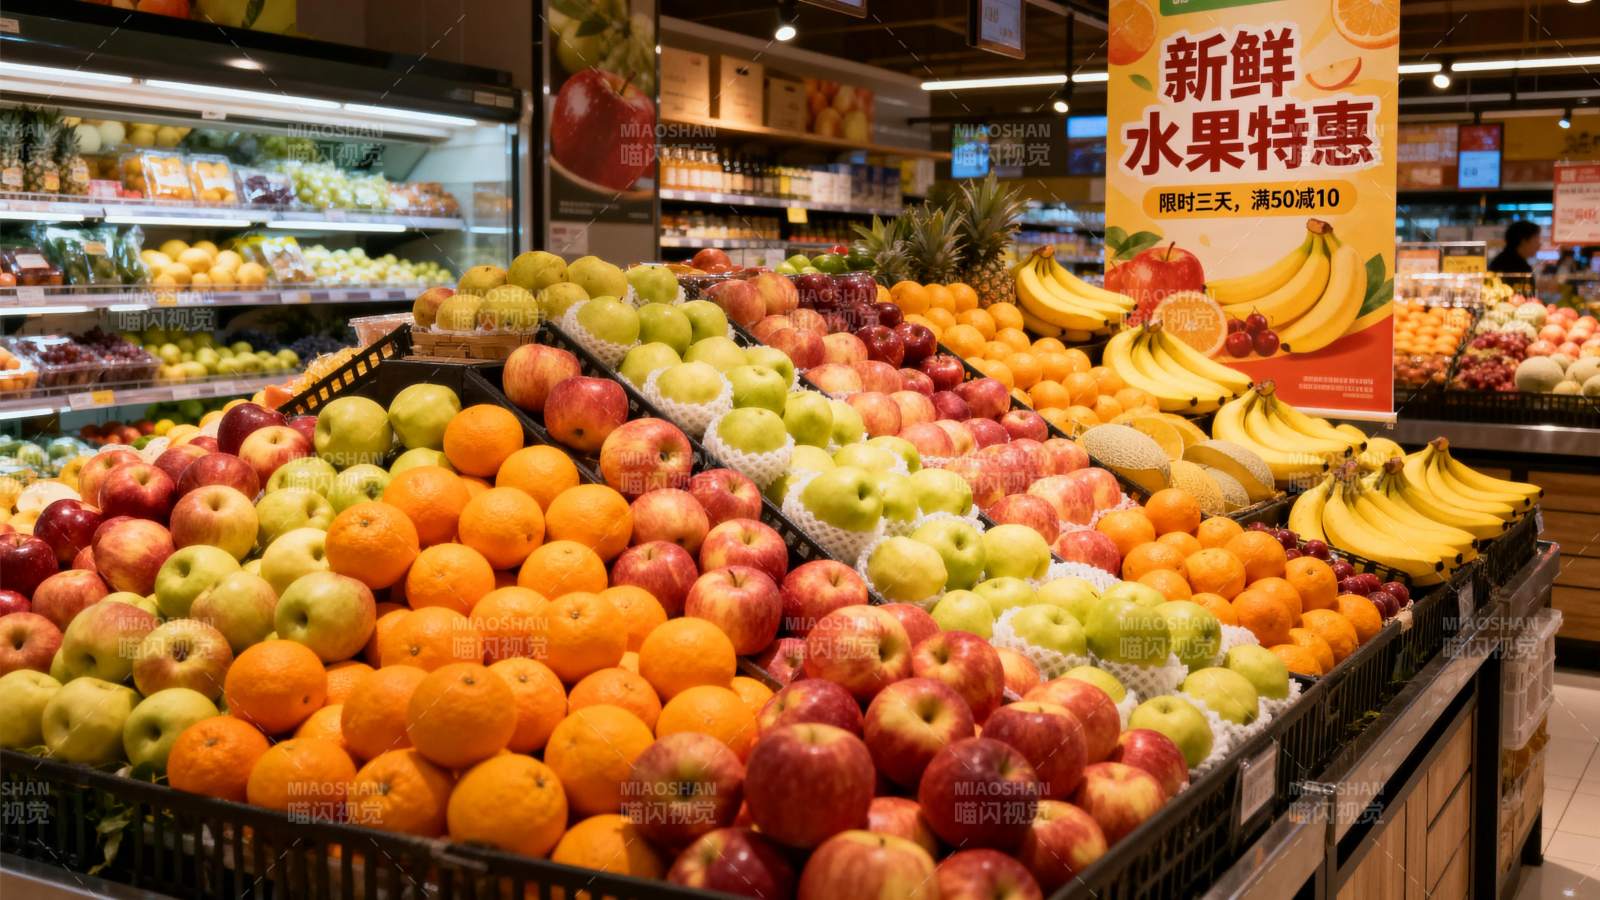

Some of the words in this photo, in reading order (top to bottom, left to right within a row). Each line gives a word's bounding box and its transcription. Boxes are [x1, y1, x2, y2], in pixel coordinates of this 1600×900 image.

[1164, 28, 1295, 103] 新鲜
[1125, 100, 1374, 176] 水果特惠
[1159, 187, 1340, 214] 限时三天，满50减10
